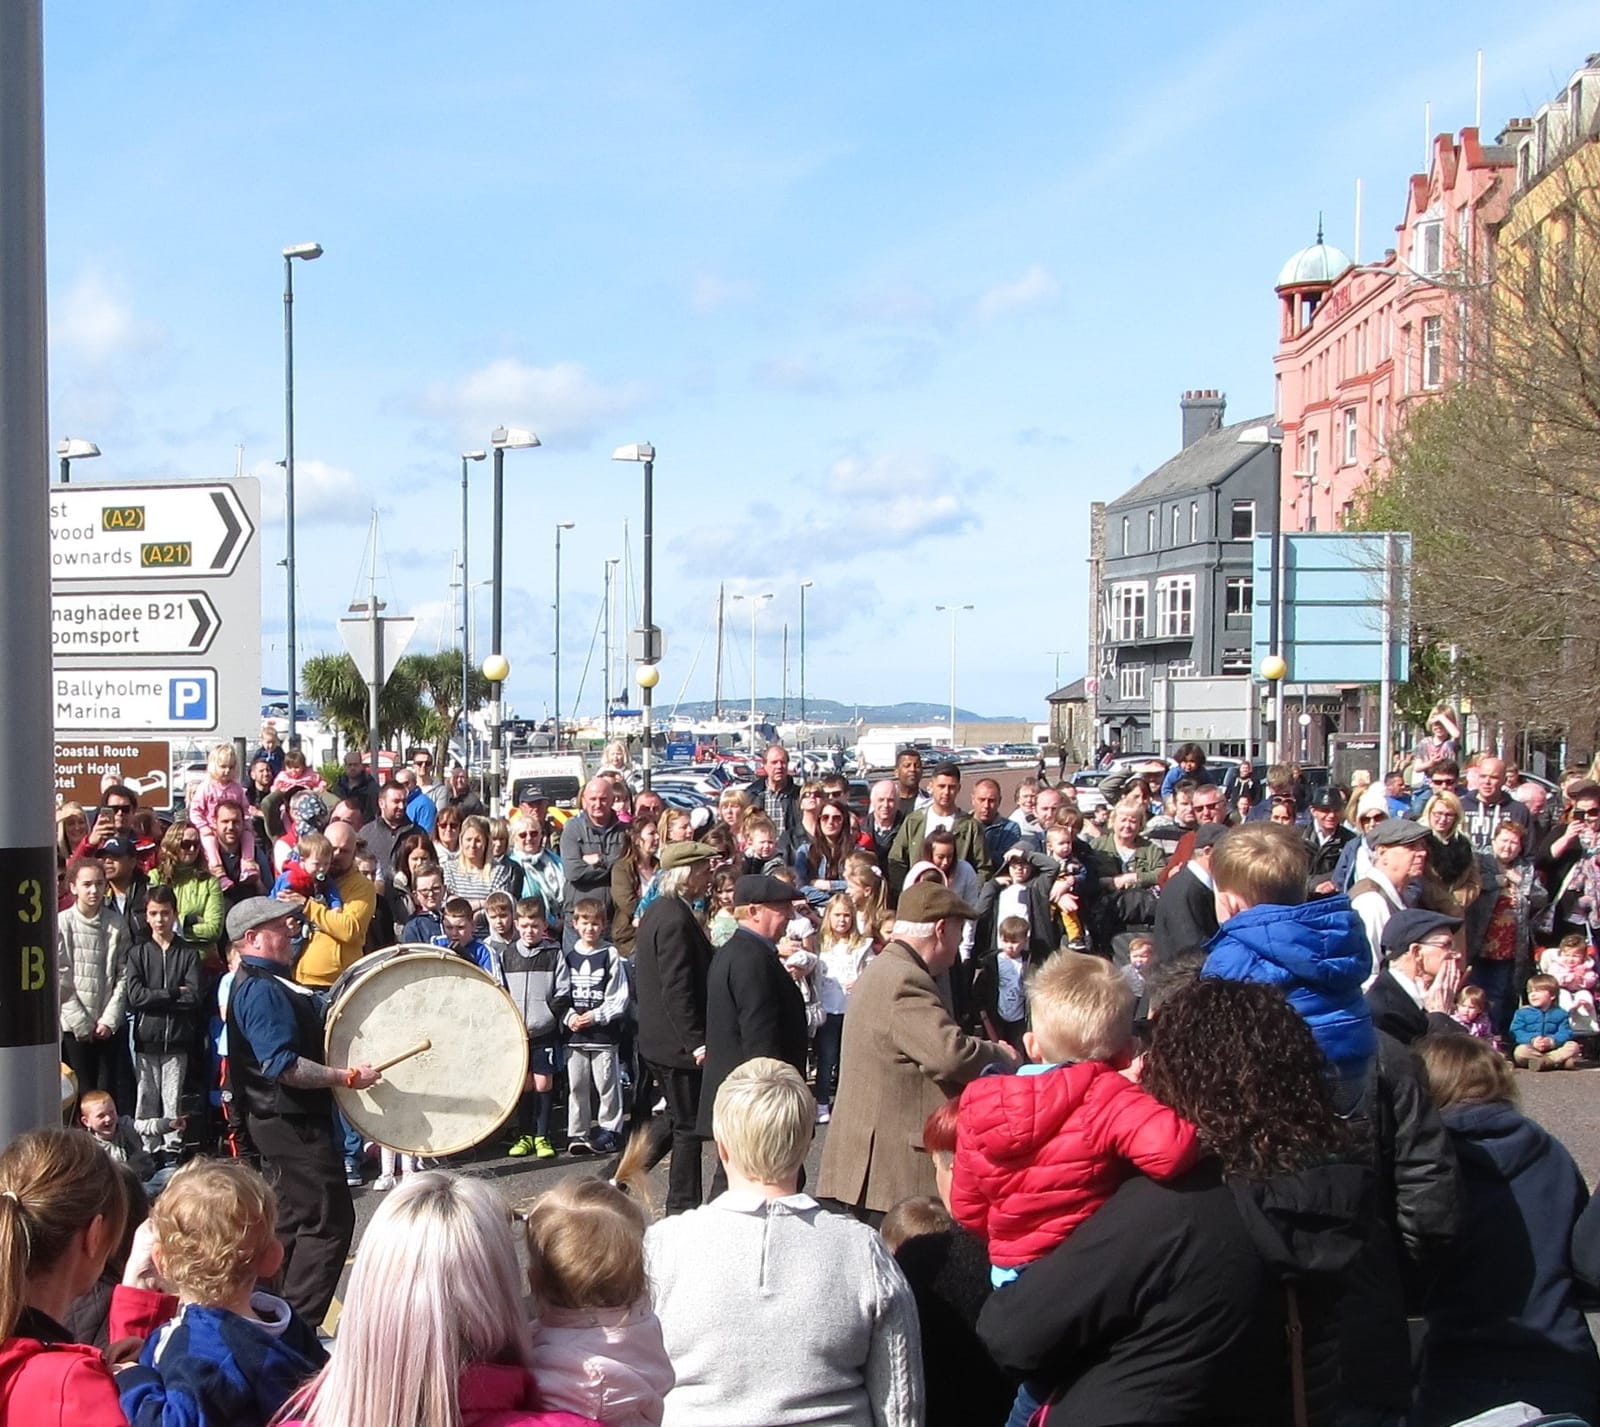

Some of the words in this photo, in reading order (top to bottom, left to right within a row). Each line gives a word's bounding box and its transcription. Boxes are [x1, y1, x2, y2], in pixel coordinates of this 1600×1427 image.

[103, 508, 144, 530] (A2)
[52, 547, 133, 565] ownards
[142, 544, 191, 566] (A21)
[52, 603, 142, 624] naghadee
[57, 680, 163, 699] Ballyholme
[57, 703, 121, 719] Marina
[54, 745, 99, 757] Coastal
[103, 745, 139, 757] Route
[87, 763, 121, 775] Hotel
[520, 767, 576, 777] AMBULANCE
[18, 880, 42, 922] 3
[22, 946, 45, 990] B
[571, 986, 604, 1000] didas
[544, 1047, 554, 1065] 7
